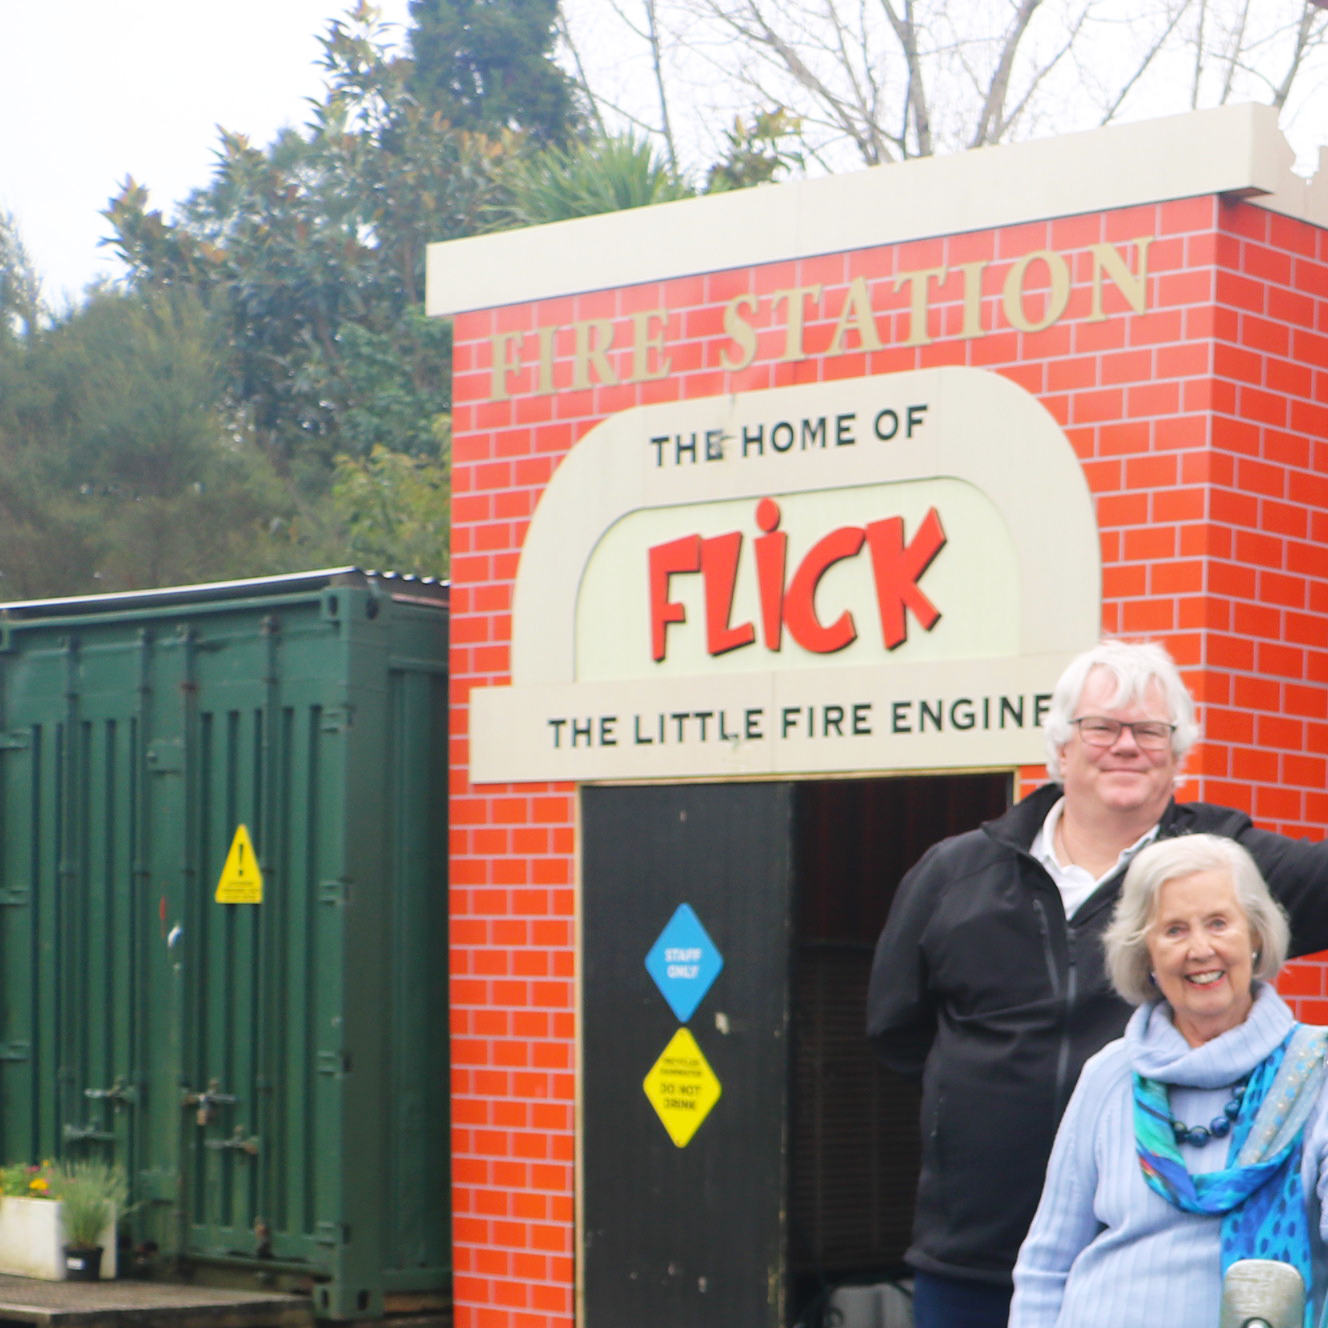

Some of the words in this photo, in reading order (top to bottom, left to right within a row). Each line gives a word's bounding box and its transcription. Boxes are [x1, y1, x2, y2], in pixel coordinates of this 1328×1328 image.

[484, 307, 673, 402] FIRE
[718, 236, 1155, 374] STATION
[650, 428, 724, 468] THE
[741, 412, 857, 458] HOME
[873, 403, 929, 441] OF
[547, 716, 618, 750] THE
[633, 708, 765, 745] LITTLE
[780, 702, 873, 740] FIRE
[890, 692, 1054, 735] ENGINE
[664, 948, 702, 963] STAFF
[667, 965, 699, 979] ONLY
[660, 1082, 675, 1094] DO
[680, 1083, 702, 1096] NOT
[664, 1098, 696, 1110] DRINK
